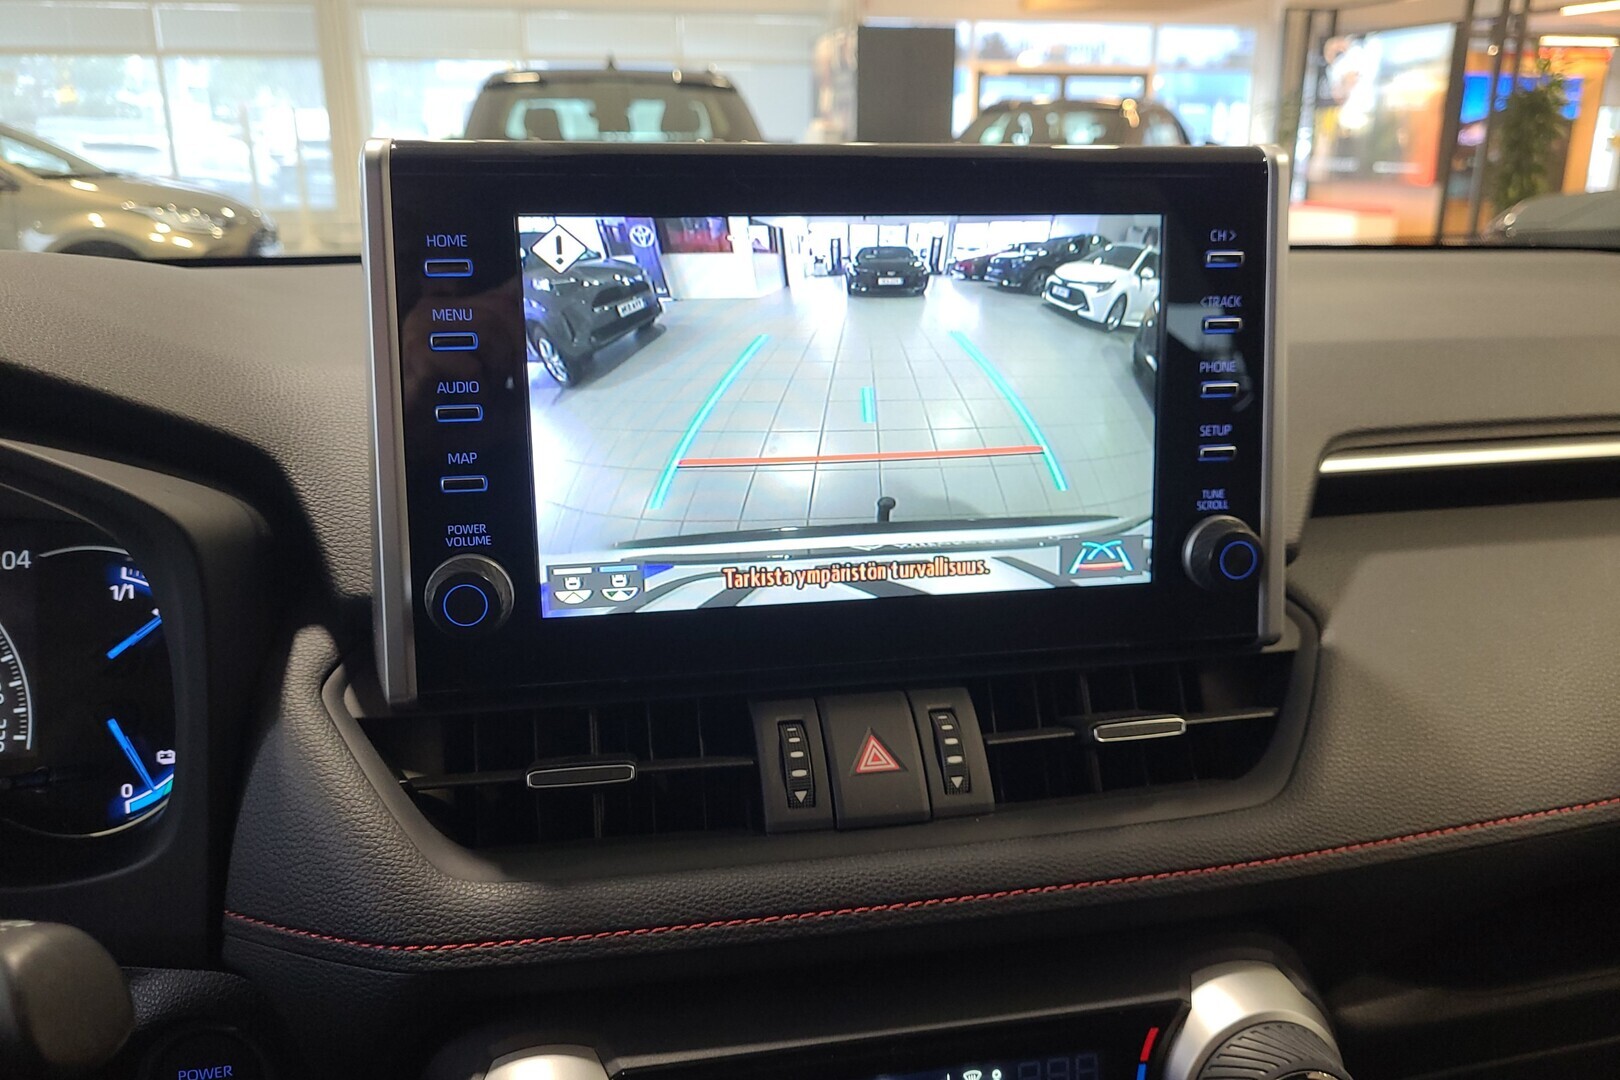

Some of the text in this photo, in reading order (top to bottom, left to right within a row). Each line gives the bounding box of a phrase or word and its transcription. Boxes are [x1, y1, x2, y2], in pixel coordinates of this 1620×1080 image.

[426, 234, 469, 248] HOME
[432, 308, 473, 321] MENU
[1200, 360, 1237, 373] PHONE
[436, 381, 480, 394] AUDIO
[1199, 424, 1233, 437] SETUP
[447, 452, 478, 465] MAP
[1202, 488, 1226, 499] TUNE
[1196, 500, 1230, 511] SCROLL
[447, 523, 487, 535] POWER
[445, 535, 492, 547] VOLUME
[722, 556, 991, 590] Tarkista ympäristön turvallisuus.
[109, 583, 135, 601] 1/1
[178, 1065, 233, 1080] POWER
